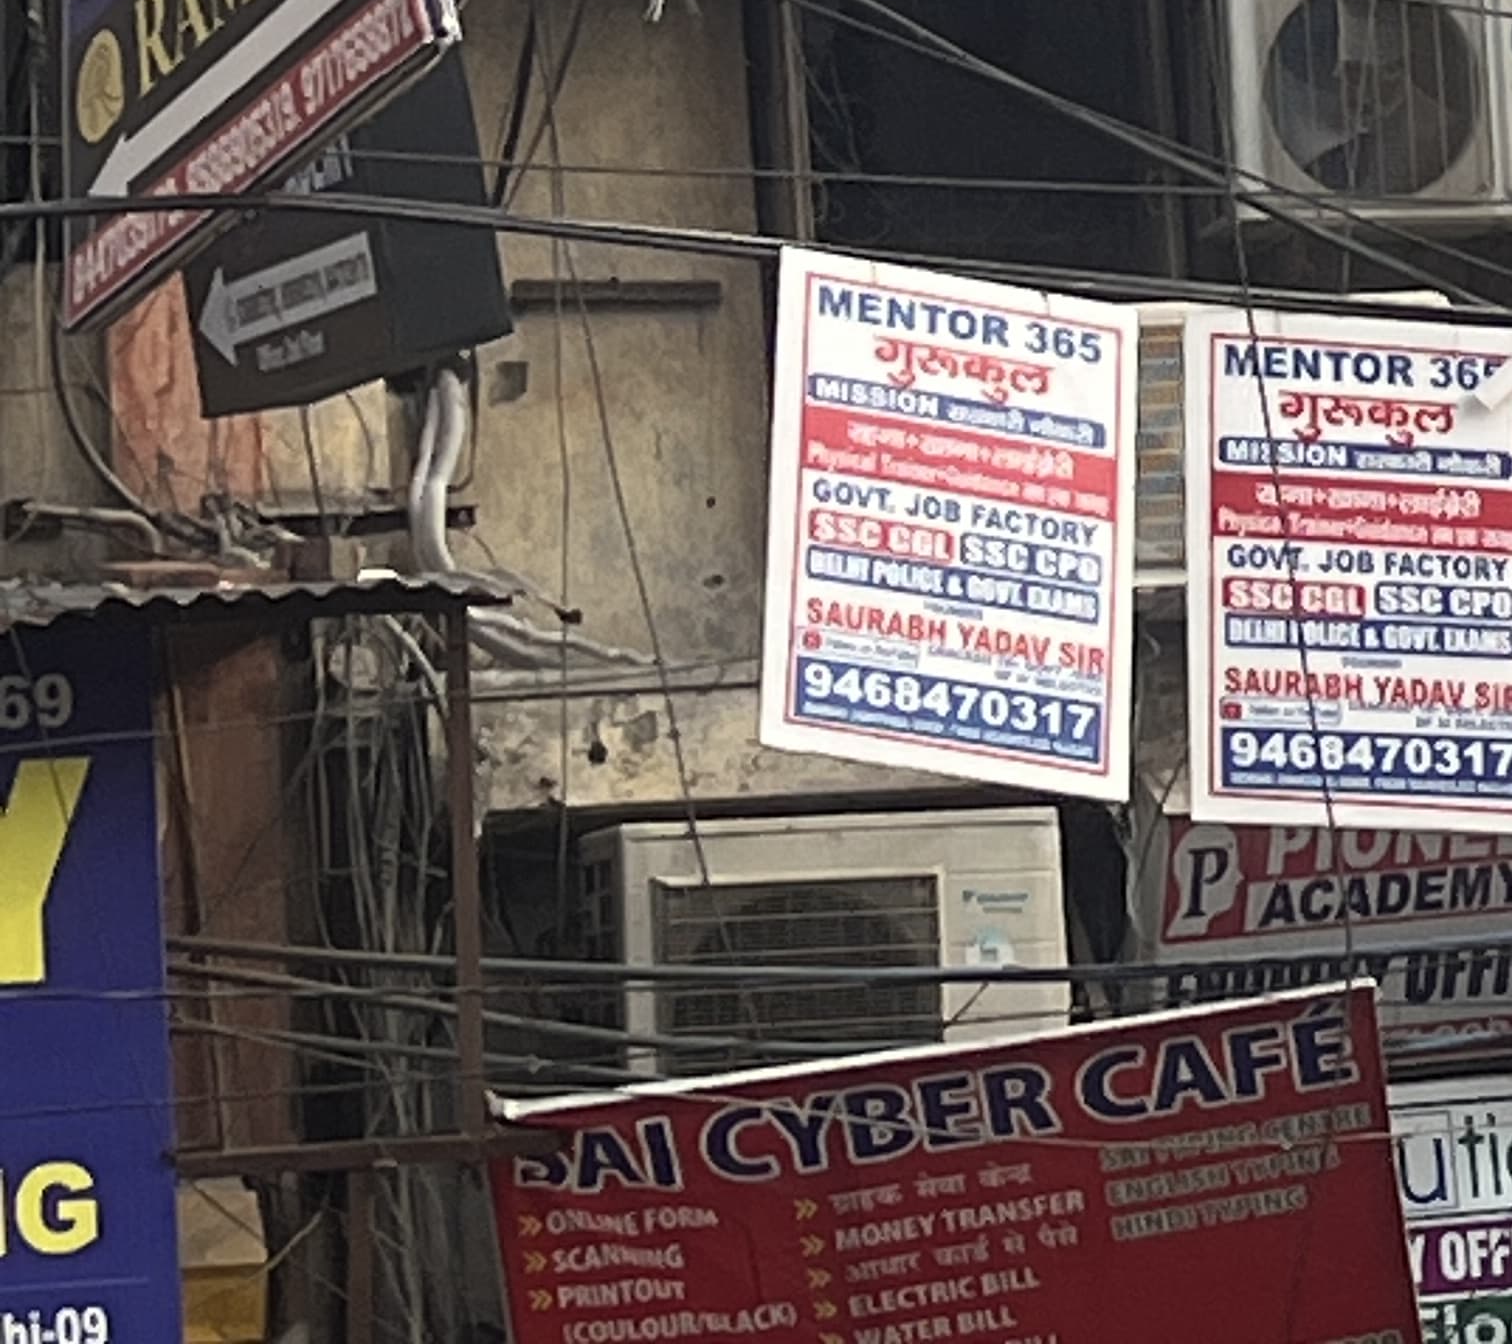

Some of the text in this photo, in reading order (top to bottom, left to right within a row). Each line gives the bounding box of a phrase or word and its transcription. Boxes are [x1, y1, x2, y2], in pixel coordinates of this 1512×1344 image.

[818, 285, 1102, 364] MENTOR 365
[1223, 343, 1414, 388] MENTOR
[814, 377, 939, 419] MISSION
[1226, 439, 1348, 467] MISSION
[811, 478, 1099, 547] GOVT. JOB FACTORY
[812, 510, 883, 549] SSC
[963, 535, 1029, 571] SSC
[1034, 547, 1101, 583] CPO
[1317, 548, 1375, 573] JOB
[1384, 552, 1509, 582] FACTORY
[1228, 579, 1512, 618] SSC CGL SSC CPO
[807, 597, 948, 646] SAURABH
[957, 621, 1052, 664] YADAV
[1058, 641, 1105, 675] SIR
[803, 662, 1097, 740] 9468470317
[1224, 667, 1363, 706] SAURABH
[1373, 675, 1465, 707] YADAV
[699, 1060, 1077, 1186] CYBER
[1077, 999, 1360, 1124] CAFÉ
[1105, 1163, 1230, 1207] ENGLISH
[1200, 1184, 1309, 1227] TYPING
[546, 1206, 720, 1237] ONLINE FORM
[834, 1189, 1086, 1252] MONEY TRANSFER
[552, 1242, 686, 1274] SCANNING
[557, 1278, 686, 1309] PRINTOUT
[847, 1265, 1041, 1318] ELECTRIC BILL
[853, 1305, 1018, 1344] WATER BILL
